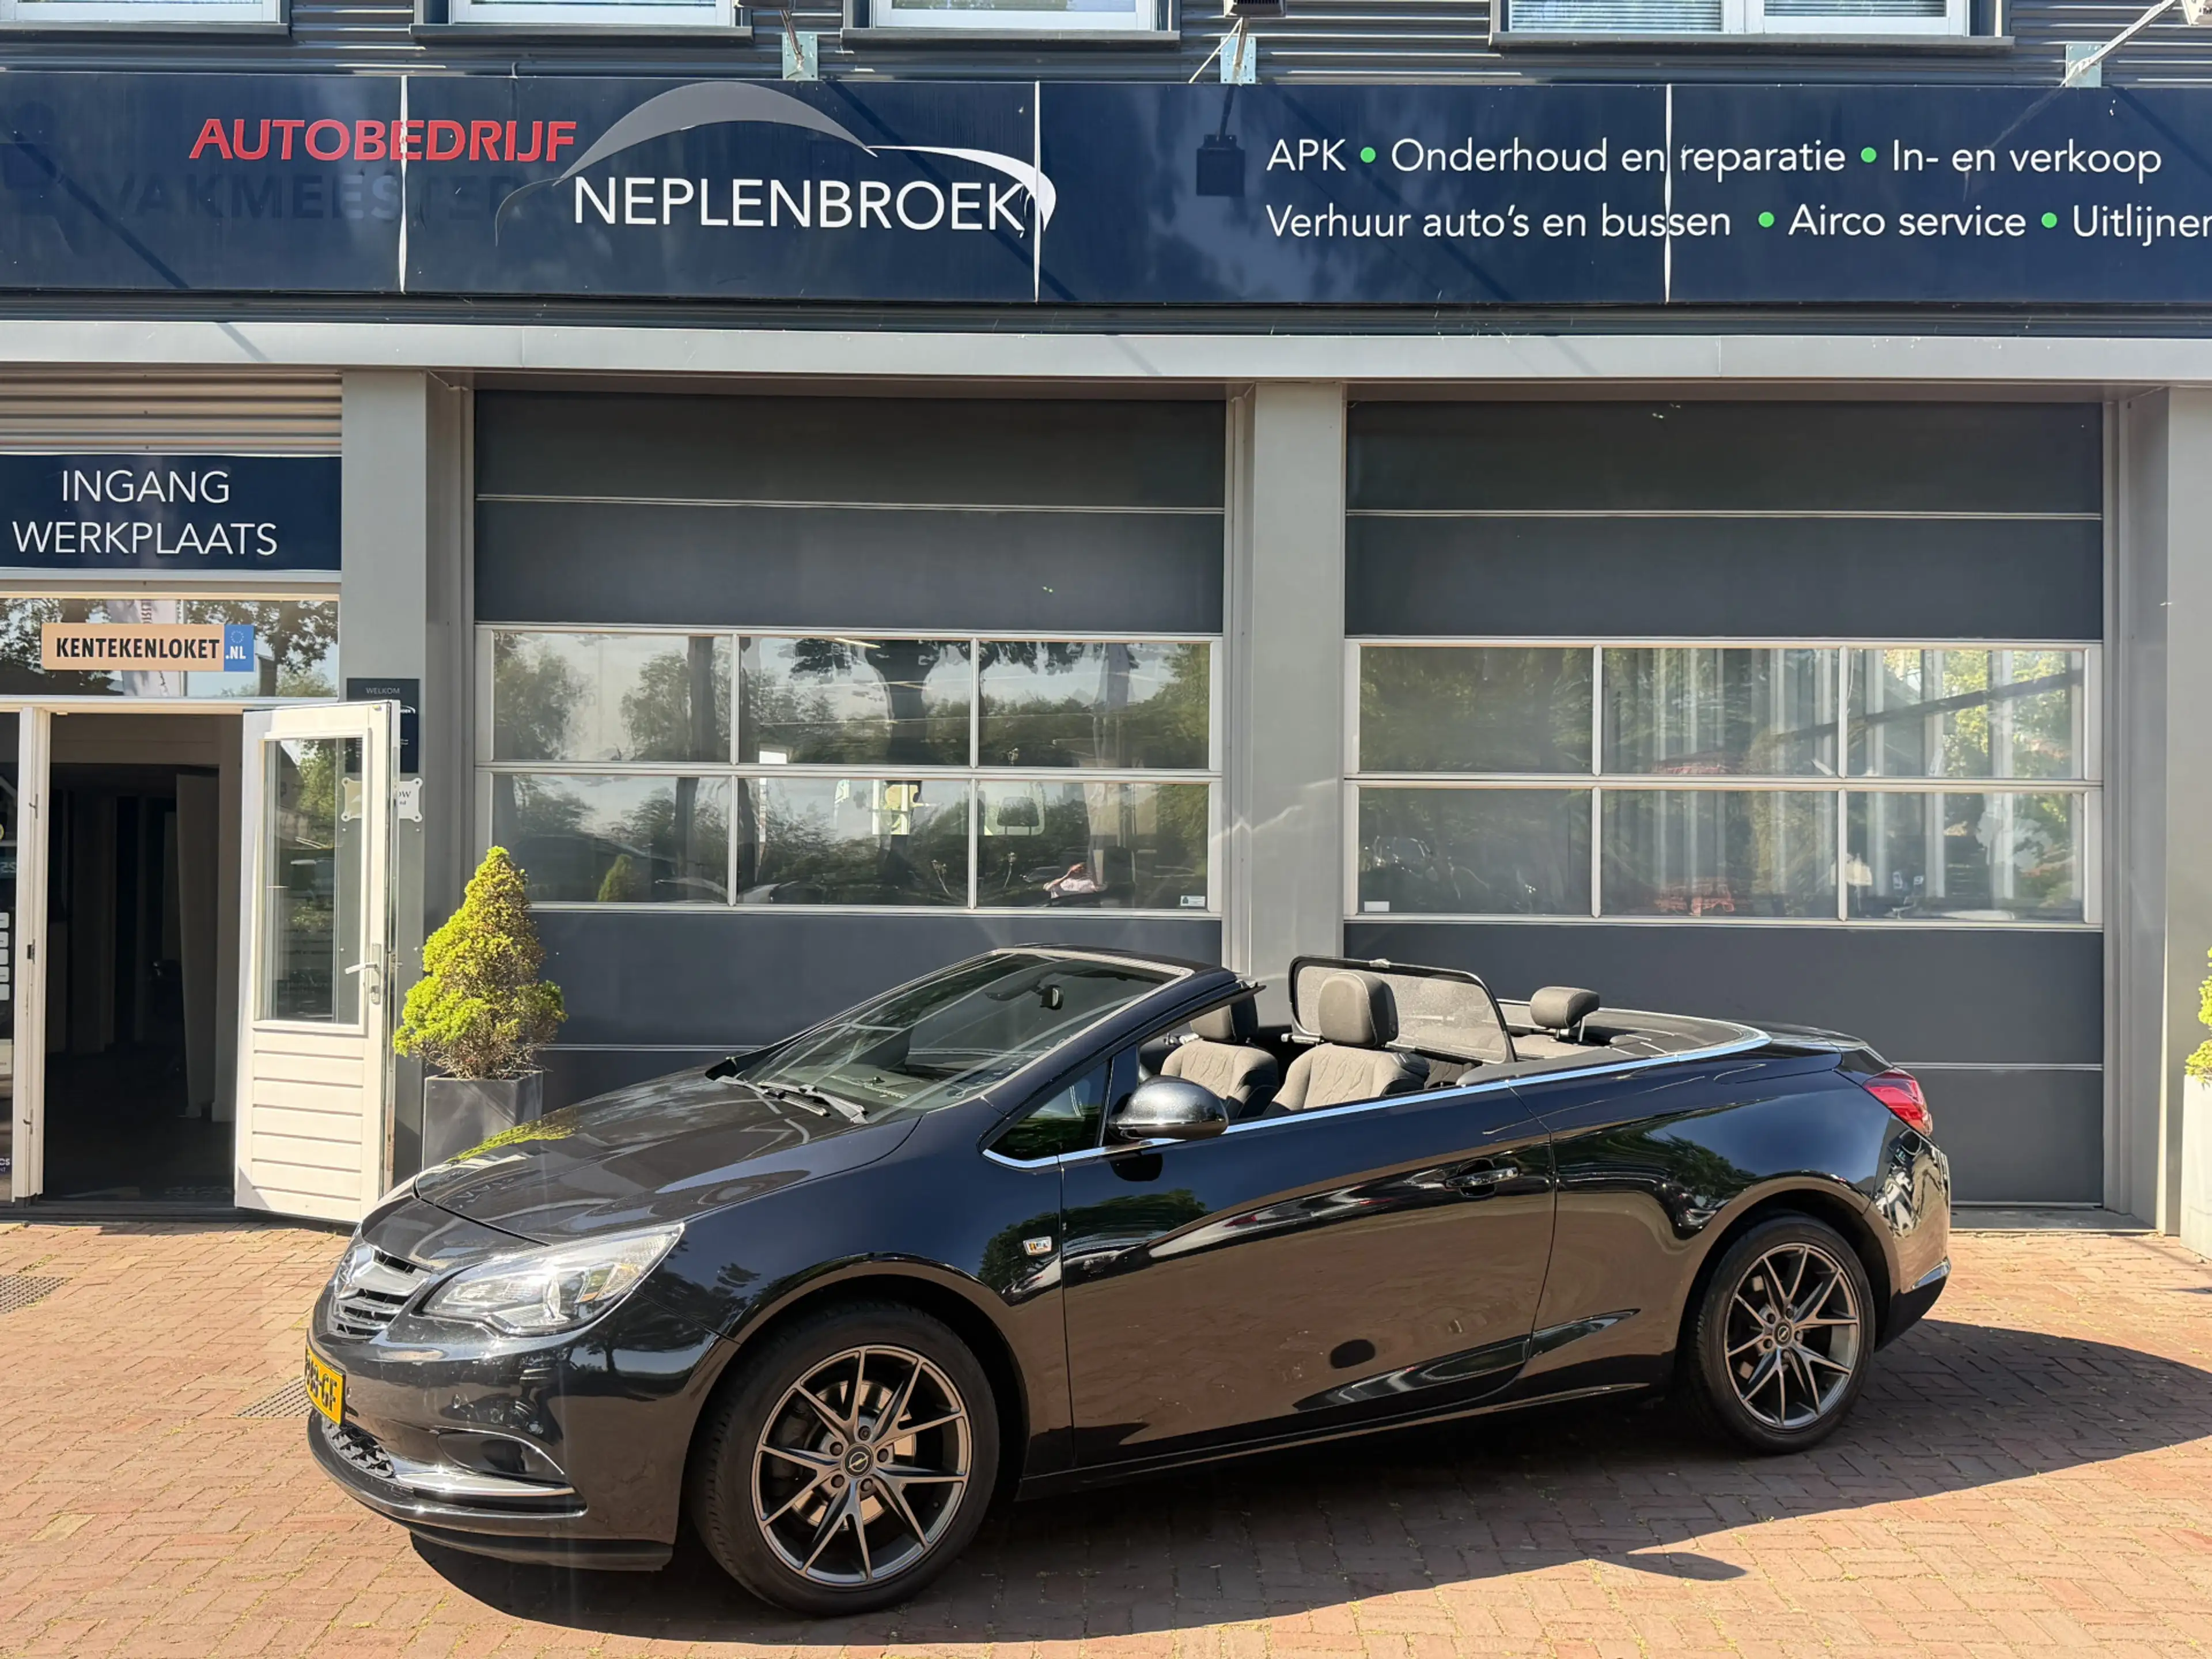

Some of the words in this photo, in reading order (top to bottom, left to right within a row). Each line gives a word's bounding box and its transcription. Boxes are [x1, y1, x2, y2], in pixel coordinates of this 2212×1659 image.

[190, 119, 577, 162] AUTOBEDRIJF
[1266, 139, 1346, 171] APK
[1392, 137, 1607, 172] Onderhoud
[1622, 149, 1665, 172] en
[1680, 139, 1846, 183] reparatie
[1894, 139, 1938, 171] In-
[1952, 149, 1995, 172] en
[2009, 138, 2161, 184] verkoop
[575, 176, 1025, 232] NEPLENBROEK
[1266, 202, 1411, 237] Verhuur
[1543, 214, 1586, 237] en
[1602, 203, 1730, 237] bussen
[1788, 203, 1885, 236] Airco
[1899, 205, 2026, 236] service
[63, 469, 229, 503] INGANG
[13, 521, 278, 555] WERKPLAATS
[56, 637, 220, 659] KENTEKENLOKET
